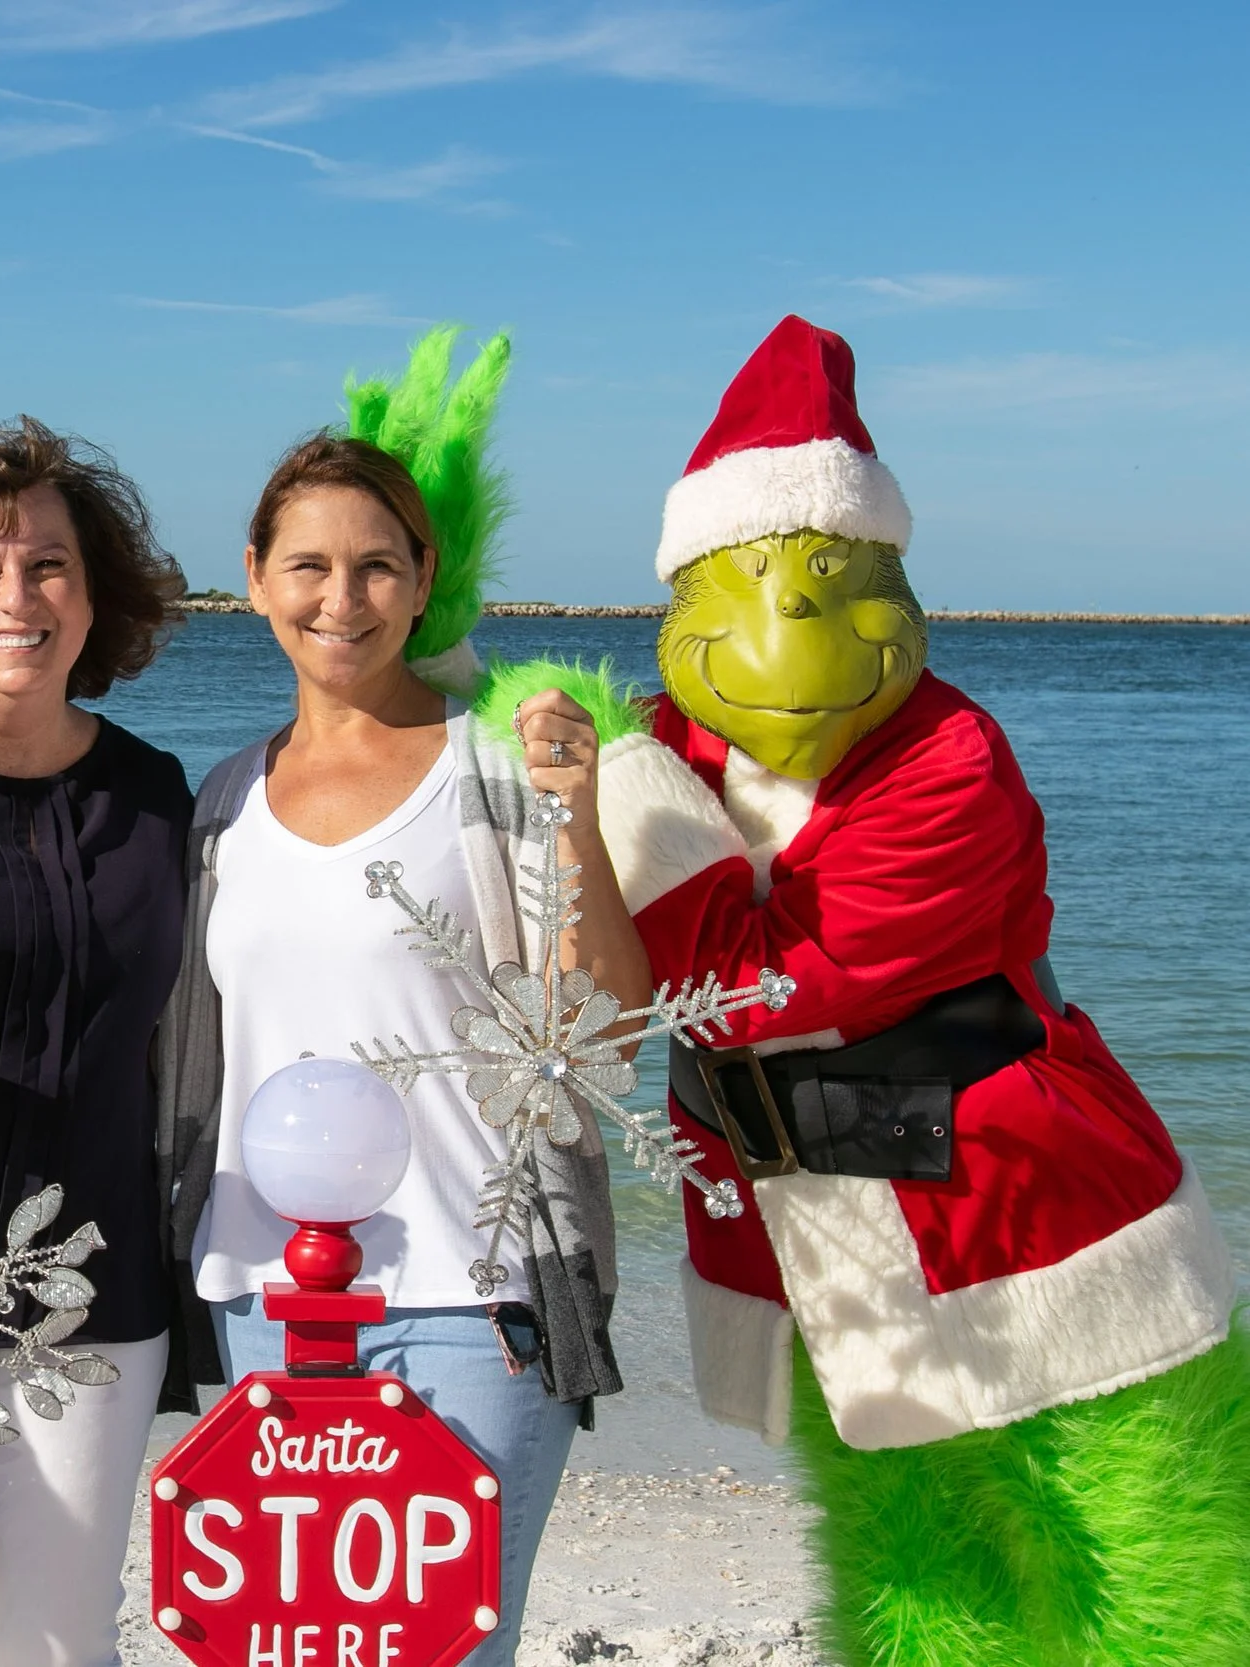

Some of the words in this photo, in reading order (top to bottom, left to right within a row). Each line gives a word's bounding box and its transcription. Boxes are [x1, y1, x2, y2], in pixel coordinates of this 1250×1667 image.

[251, 1416, 399, 1477] Santa
[183, 1494, 471, 1603] STOP
[249, 1623, 403, 1667] HERE
